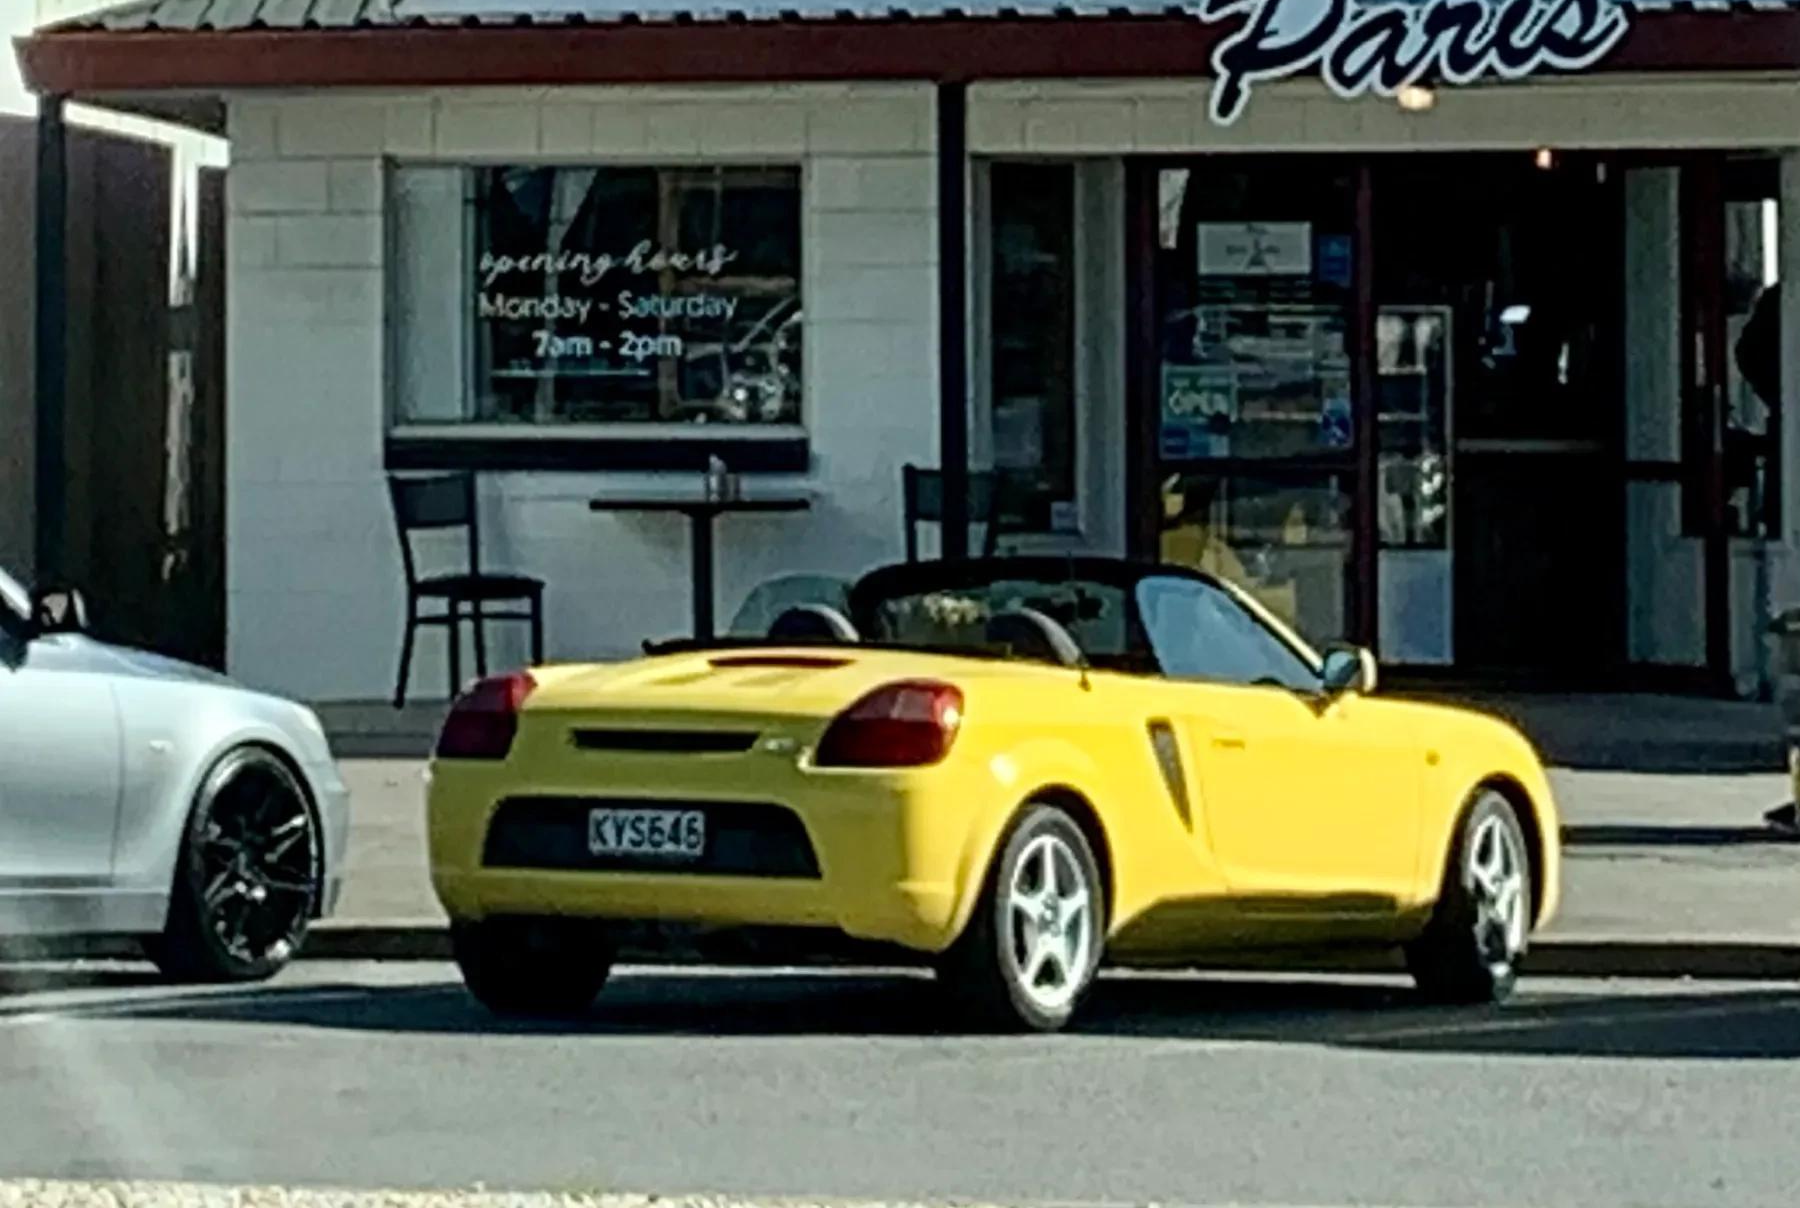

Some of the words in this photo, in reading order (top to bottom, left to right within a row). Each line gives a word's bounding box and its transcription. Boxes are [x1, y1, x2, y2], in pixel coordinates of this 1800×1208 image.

[479, 248, 613, 287] opening
[623, 238, 740, 276] hours
[478, 292, 593, 324] Monday
[618, 290, 738, 324] Saturday
[531, 329, 593, 357] 7am
[618, 330, 683, 362] 2pm
[592, 814, 702, 850] KYS646
